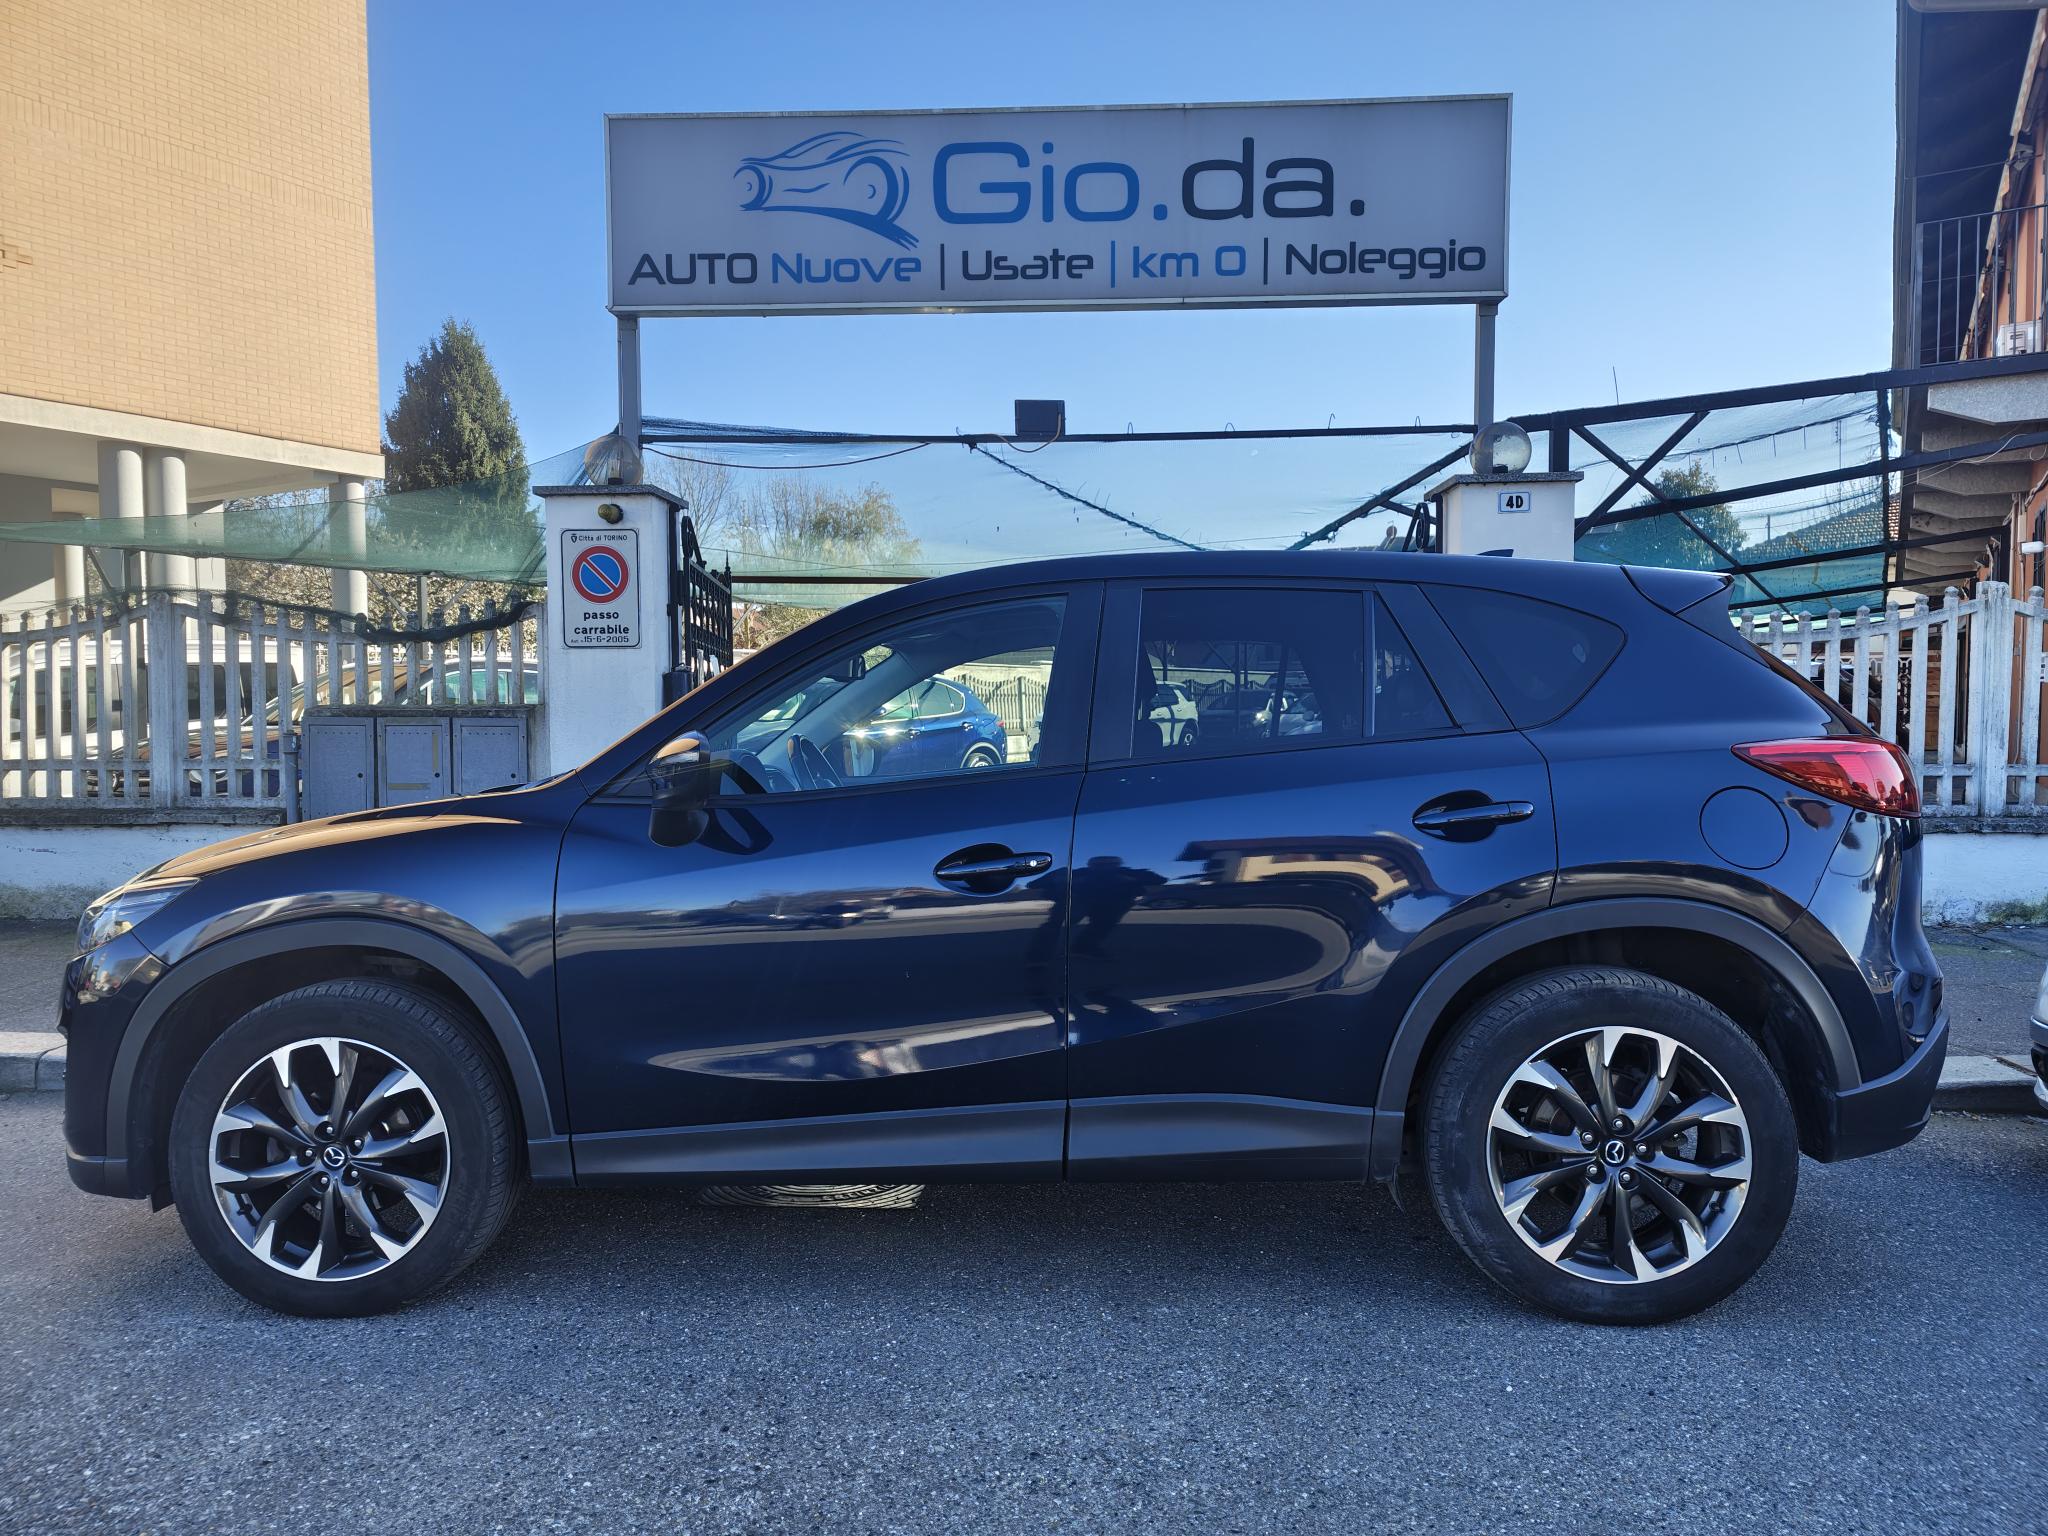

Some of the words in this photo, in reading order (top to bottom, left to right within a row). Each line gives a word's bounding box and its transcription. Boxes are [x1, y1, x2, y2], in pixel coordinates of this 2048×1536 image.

[628, 253, 757, 285] AUTO
[772, 253, 921, 284] Nuove
[962, 249, 1093, 285] Usate
[1133, 245, 1199, 278] km
[1215, 245, 1246, 276] 0
[1286, 239, 1486, 280] Noleggio
[583, 611, 619, 621] passo
[574, 624, 630, 635] carrabile
[584, 635, 629, 643] 15-6-2005
